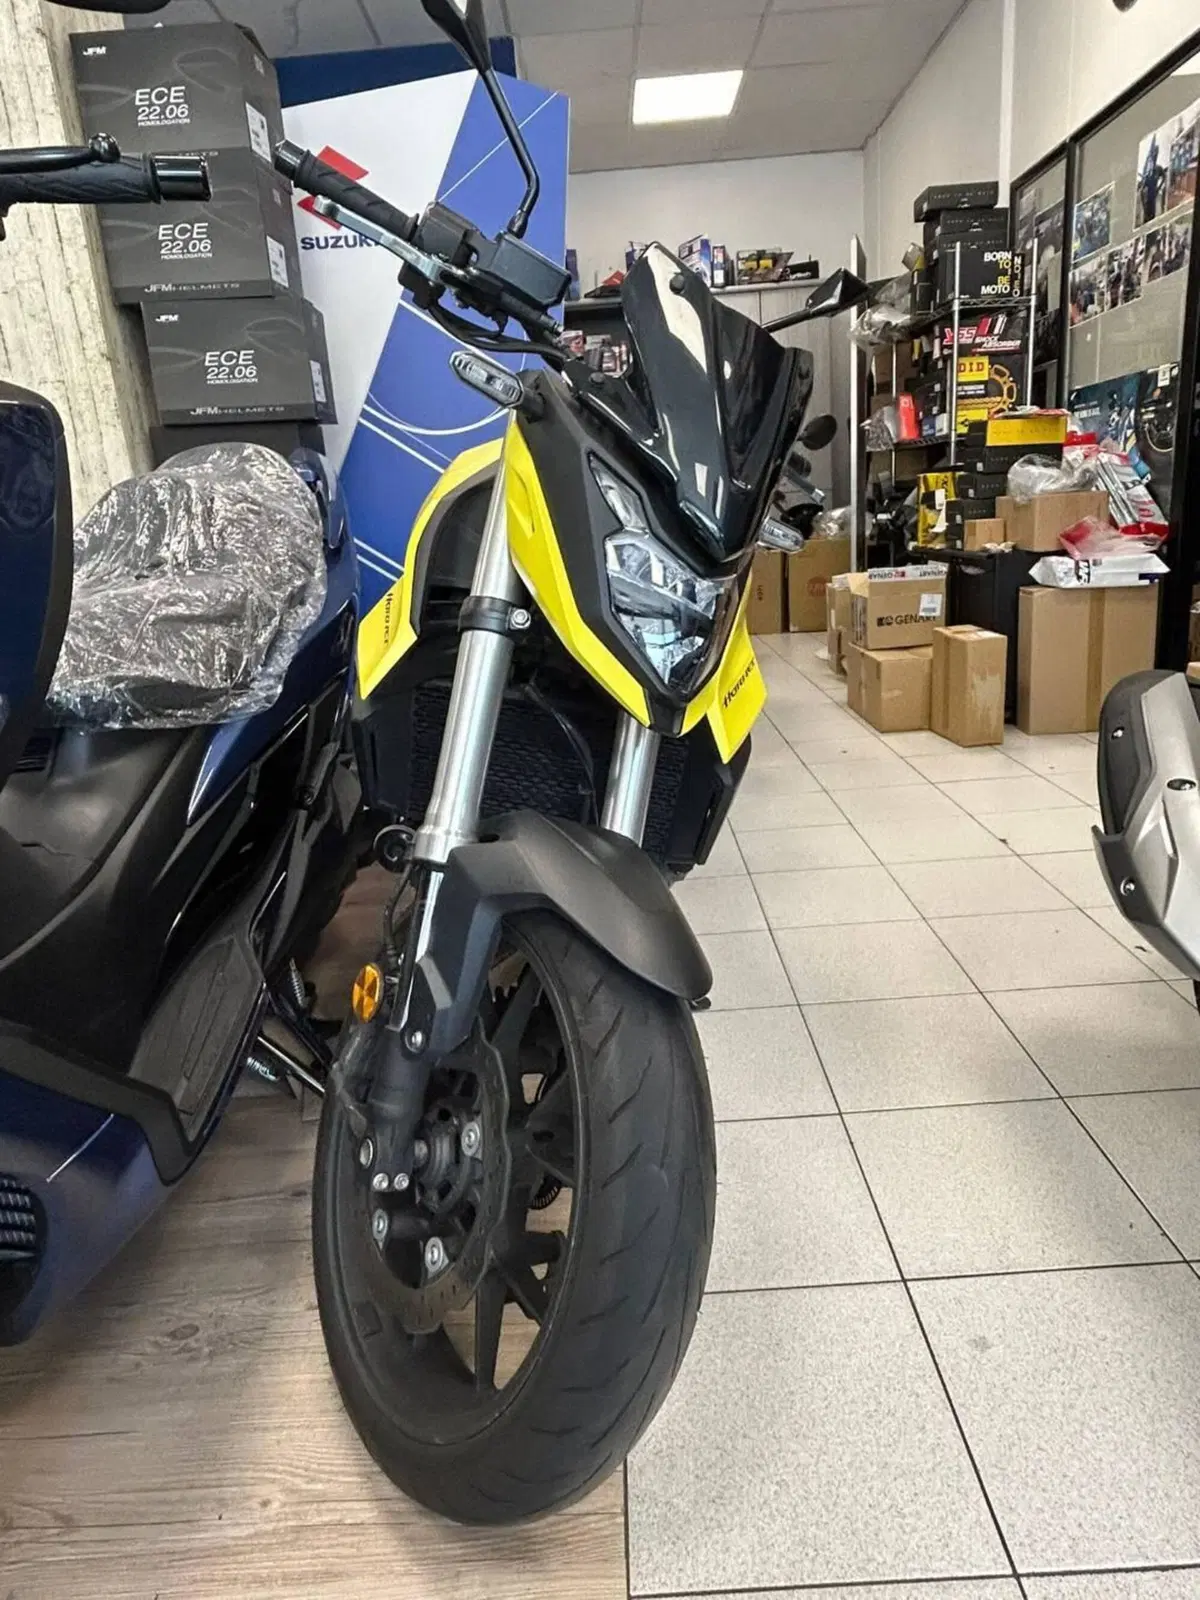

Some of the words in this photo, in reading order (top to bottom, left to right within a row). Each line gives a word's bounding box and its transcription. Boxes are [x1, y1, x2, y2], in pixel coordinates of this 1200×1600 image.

[83, 46, 106, 56] JFM
[135, 86, 186, 106] ECE
[137, 104, 189, 121] 22.06
[137, 118, 191, 127] HOMOLOGATION
[158, 222, 209, 241] ECE
[160, 239, 212, 254] 22.06
[300, 234, 380, 251] SUZUK
[160, 252, 213, 260] HOMOLOGATION
[983, 250, 1012, 263] BORN
[980, 284, 1011, 295] MOTO
[155, 313, 179, 323] JFM
[204, 349, 255, 367] ECE
[206, 365, 258, 380] 22.06
